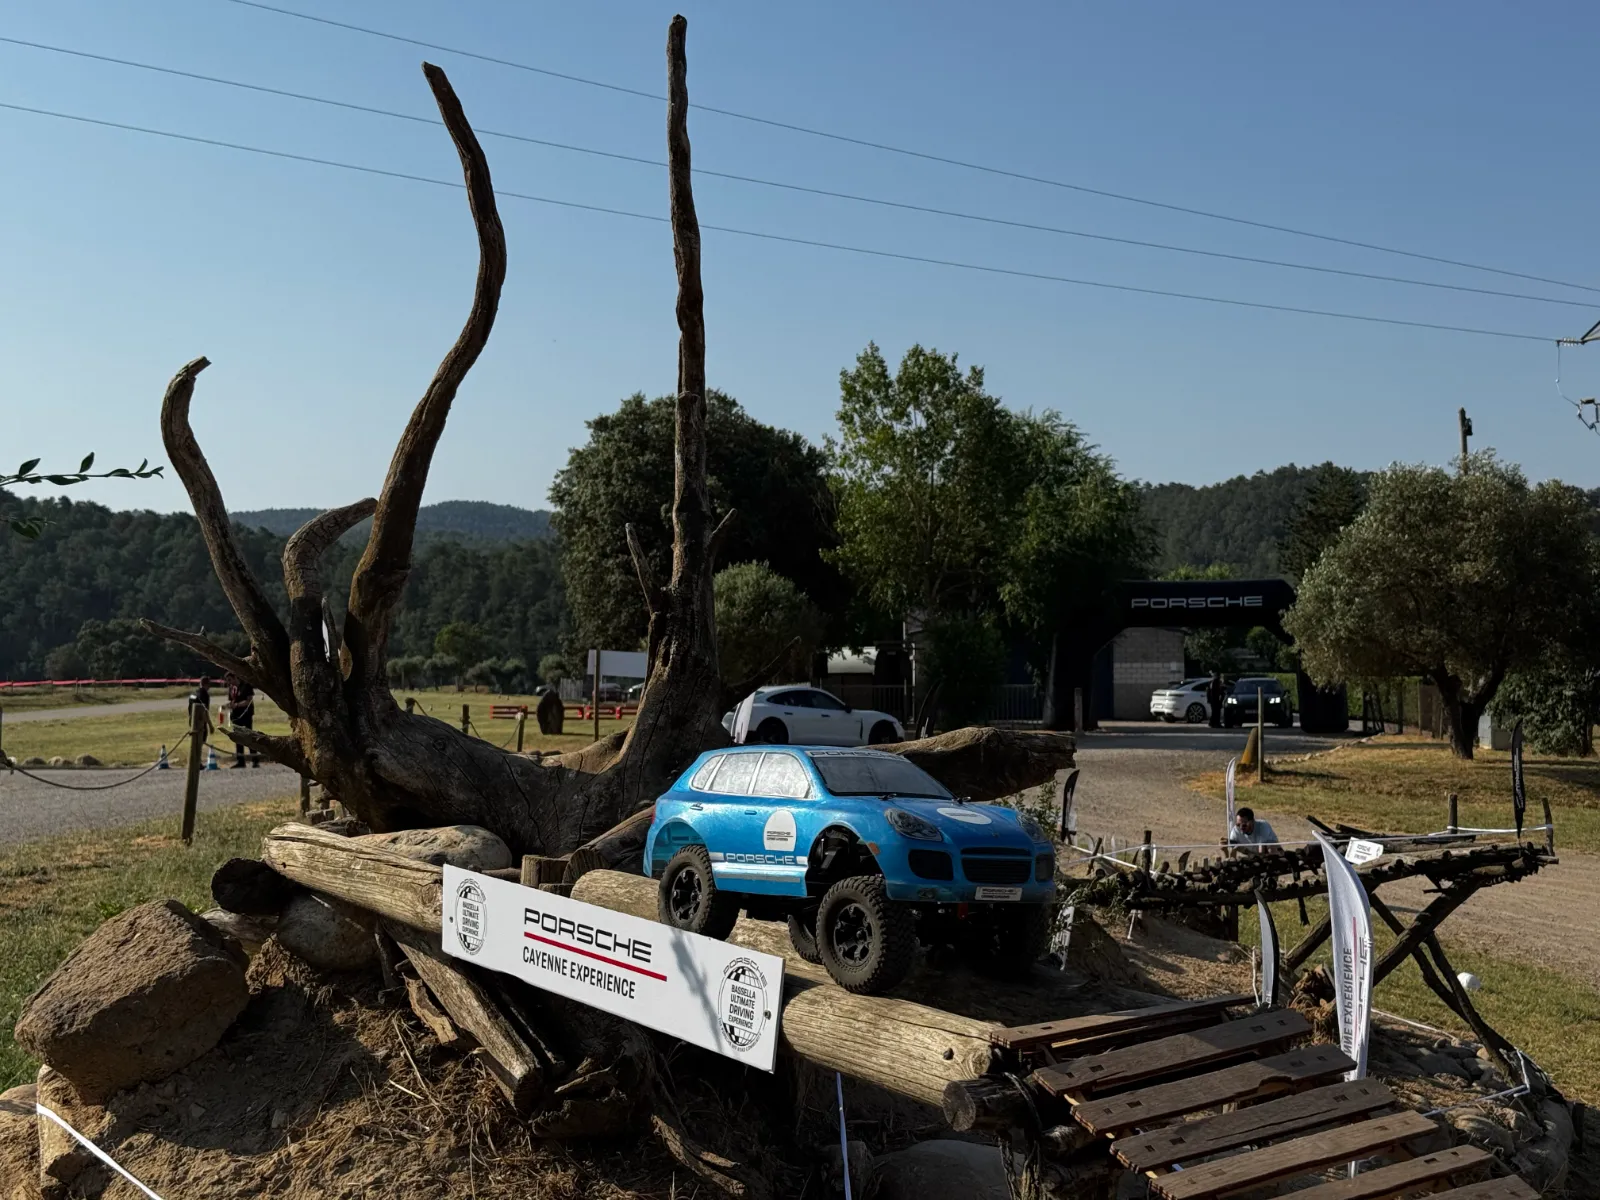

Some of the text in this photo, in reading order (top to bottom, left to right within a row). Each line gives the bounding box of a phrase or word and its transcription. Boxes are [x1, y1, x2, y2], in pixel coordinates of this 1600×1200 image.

[1131, 595, 1263, 609] PORSCHE
[725, 852, 795, 865] PORSCHE
[524, 907, 652, 963] PORSCHE
[523, 946, 567, 976] CAYENNE
[570, 961, 636, 999] EXPERIENCE
[723, 957, 768, 988] PORSCHE
[731, 984, 756, 999] BASSELLA
[730, 993, 755, 1010] ULTIMATE
[729, 1004, 754, 1021] DRIVING
[728, 1014, 753, 1030] EXPERIENCE
